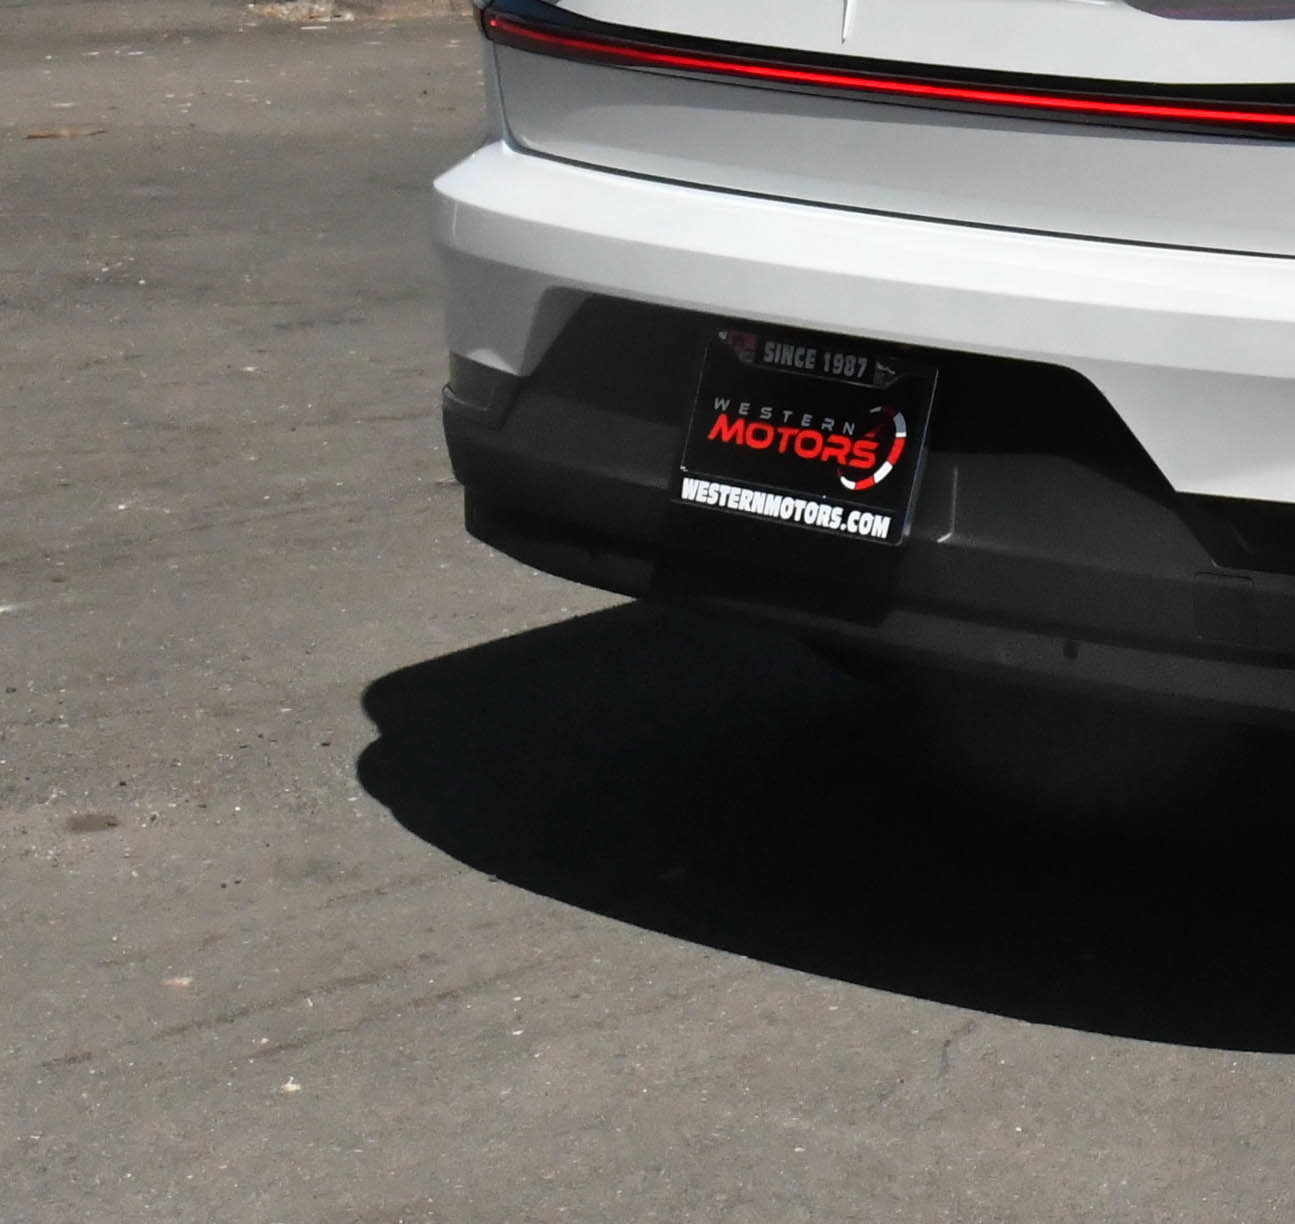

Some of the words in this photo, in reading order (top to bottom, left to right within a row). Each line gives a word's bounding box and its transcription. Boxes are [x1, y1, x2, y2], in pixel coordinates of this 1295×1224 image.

[763, 341, 817, 371] SINCE
[824, 351, 868, 379] 1987
[714, 397, 855, 435] WESTERN
[707, 413, 880, 469] MOTORS
[680, 477, 891, 539] WESTERNMOTORS.COM
